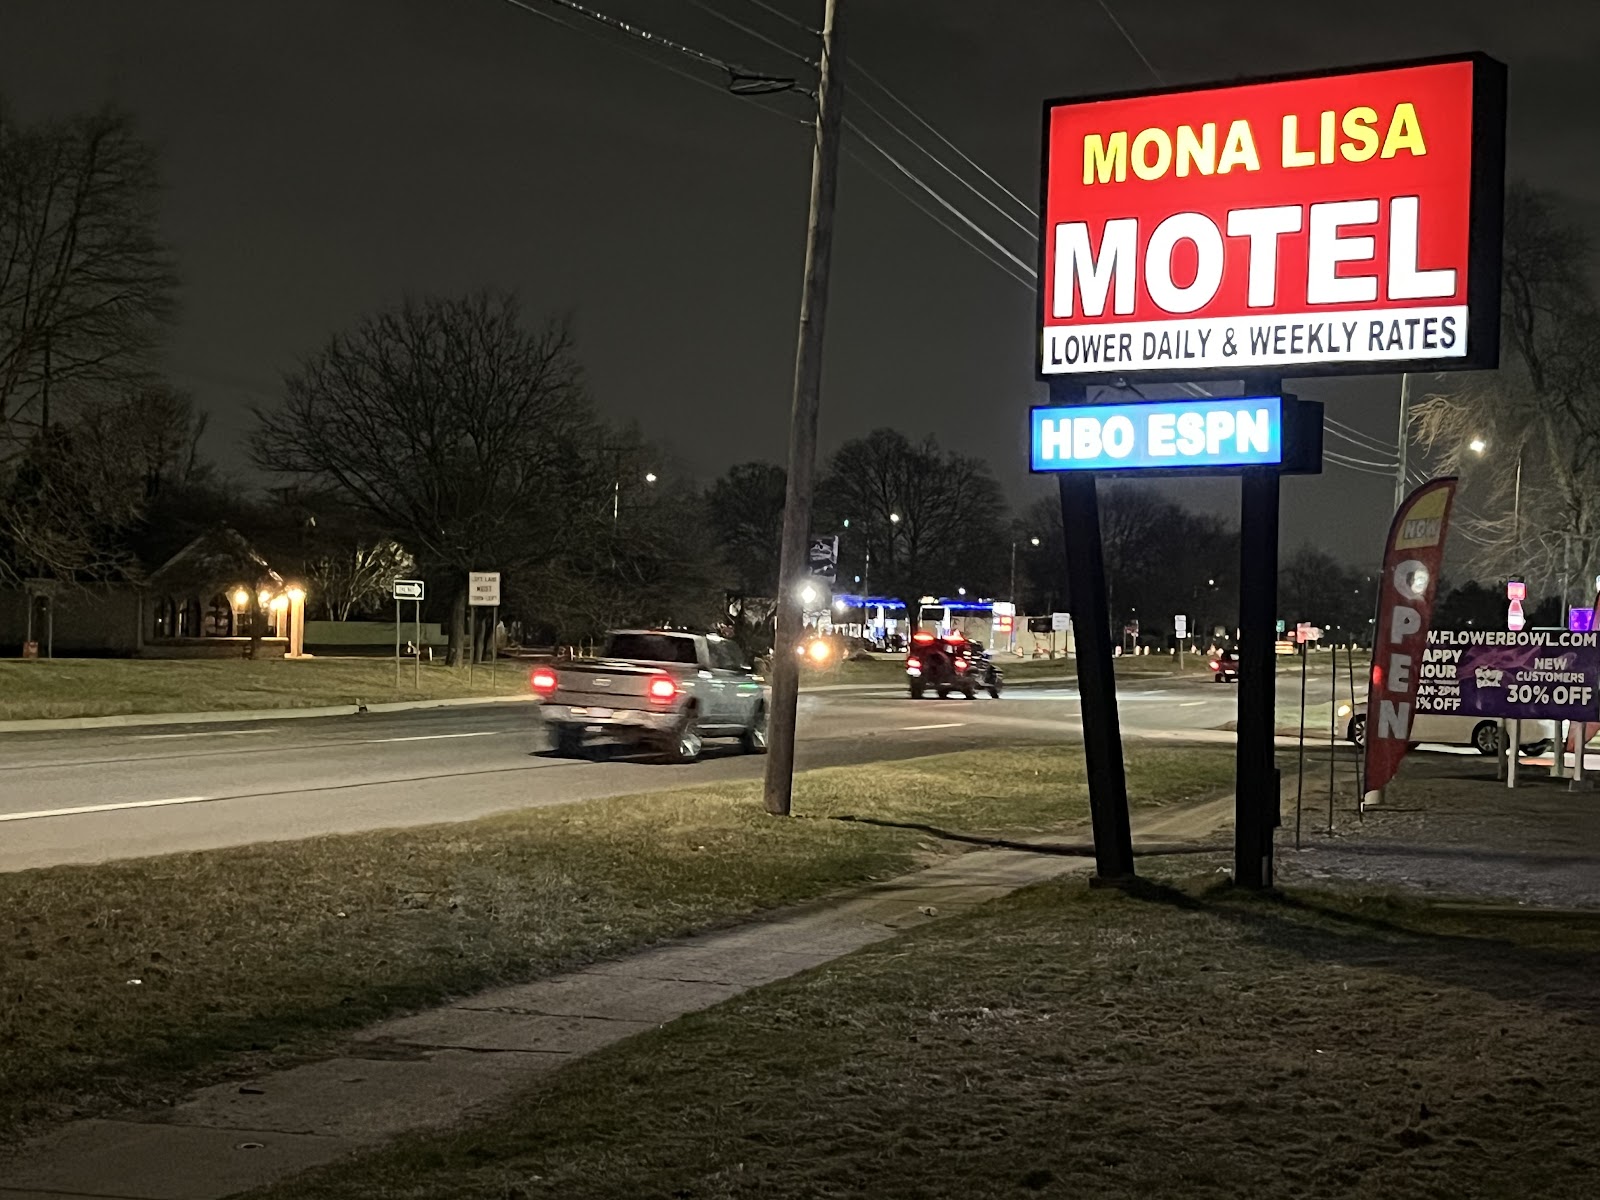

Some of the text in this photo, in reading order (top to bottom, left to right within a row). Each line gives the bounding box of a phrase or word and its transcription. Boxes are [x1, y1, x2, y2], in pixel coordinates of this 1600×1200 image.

[1083, 102, 1427, 185] MONA LISA
[1053, 195, 1457, 319] MOTEL
[1051, 316, 1457, 365] LOWER DAILY & WEEKLY RATES
[1041, 408, 1269, 459] HBO ESPN
[1405, 518, 1441, 540] NOW
[1377, 559, 1429, 740] OPEN
[1534, 657, 1568, 670] NEW
[1516, 671, 1585, 683] CUSTOMERS
[1433, 697, 1462, 710] OFF
[1506, 684, 1592, 706] 30% OFF
